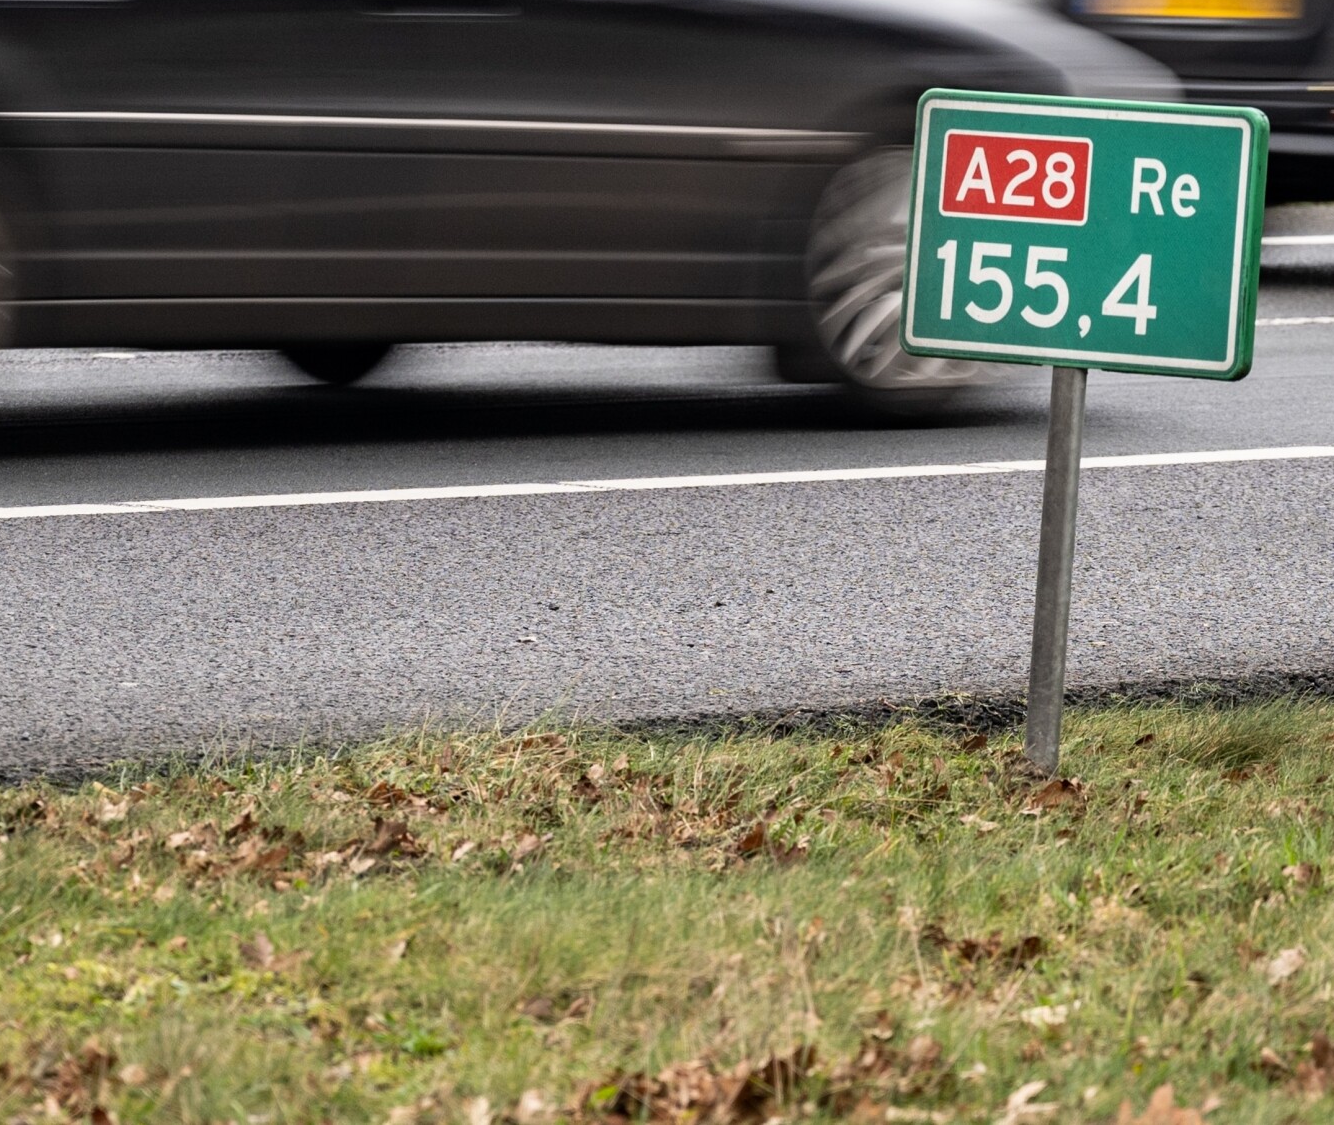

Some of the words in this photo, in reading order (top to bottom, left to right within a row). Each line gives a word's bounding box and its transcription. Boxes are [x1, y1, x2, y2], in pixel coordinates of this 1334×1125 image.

[955, 147, 1076, 209] A28
[1130, 157, 1200, 217] Re
[937, 240, 1157, 338] 155,4
